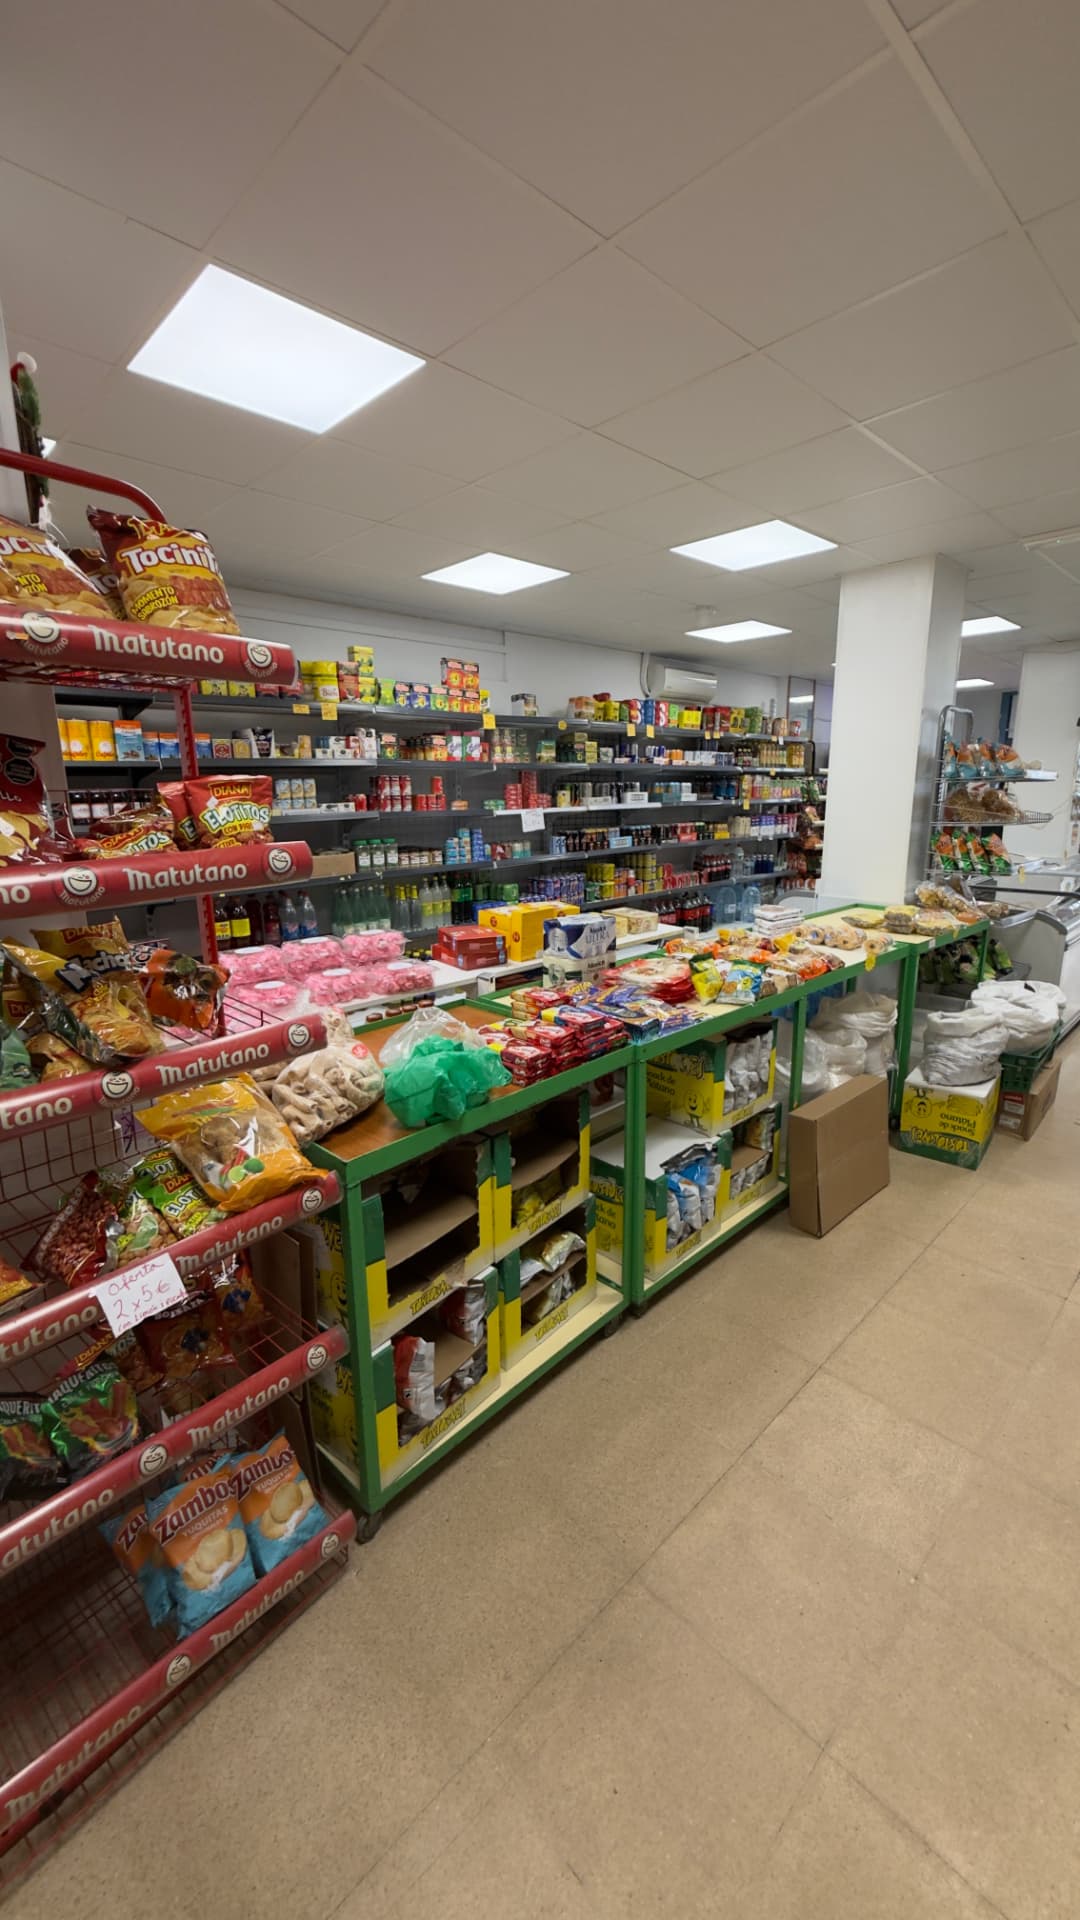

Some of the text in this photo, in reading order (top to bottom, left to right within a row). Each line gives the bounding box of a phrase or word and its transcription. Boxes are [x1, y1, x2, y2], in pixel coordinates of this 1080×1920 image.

[121, 543, 220, 574] Tocinit
[88, 624, 224, 664] Matutano
[214, 785, 249, 797] DIANA
[205, 803, 270, 830] ELOTITOS
[122, 863, 248, 891] Matutano
[56, 951, 131, 992] Nacho
[156, 1044, 270, 1086] Matutano
[176, 1216, 283, 1272] Matutano
[107, 1263, 165, 1296] Oferta
[113, 1298, 128, 1320] 2
[141, 1284, 153, 1303] 5
[187, 1376, 290, 1448] Matutano
[154, 1480, 236, 1546] Zambos
[183, 1506, 229, 1537] YUQUITAS
[209, 1569, 305, 1649] Matutano
[4, 1705, 143, 1822] Matutano
